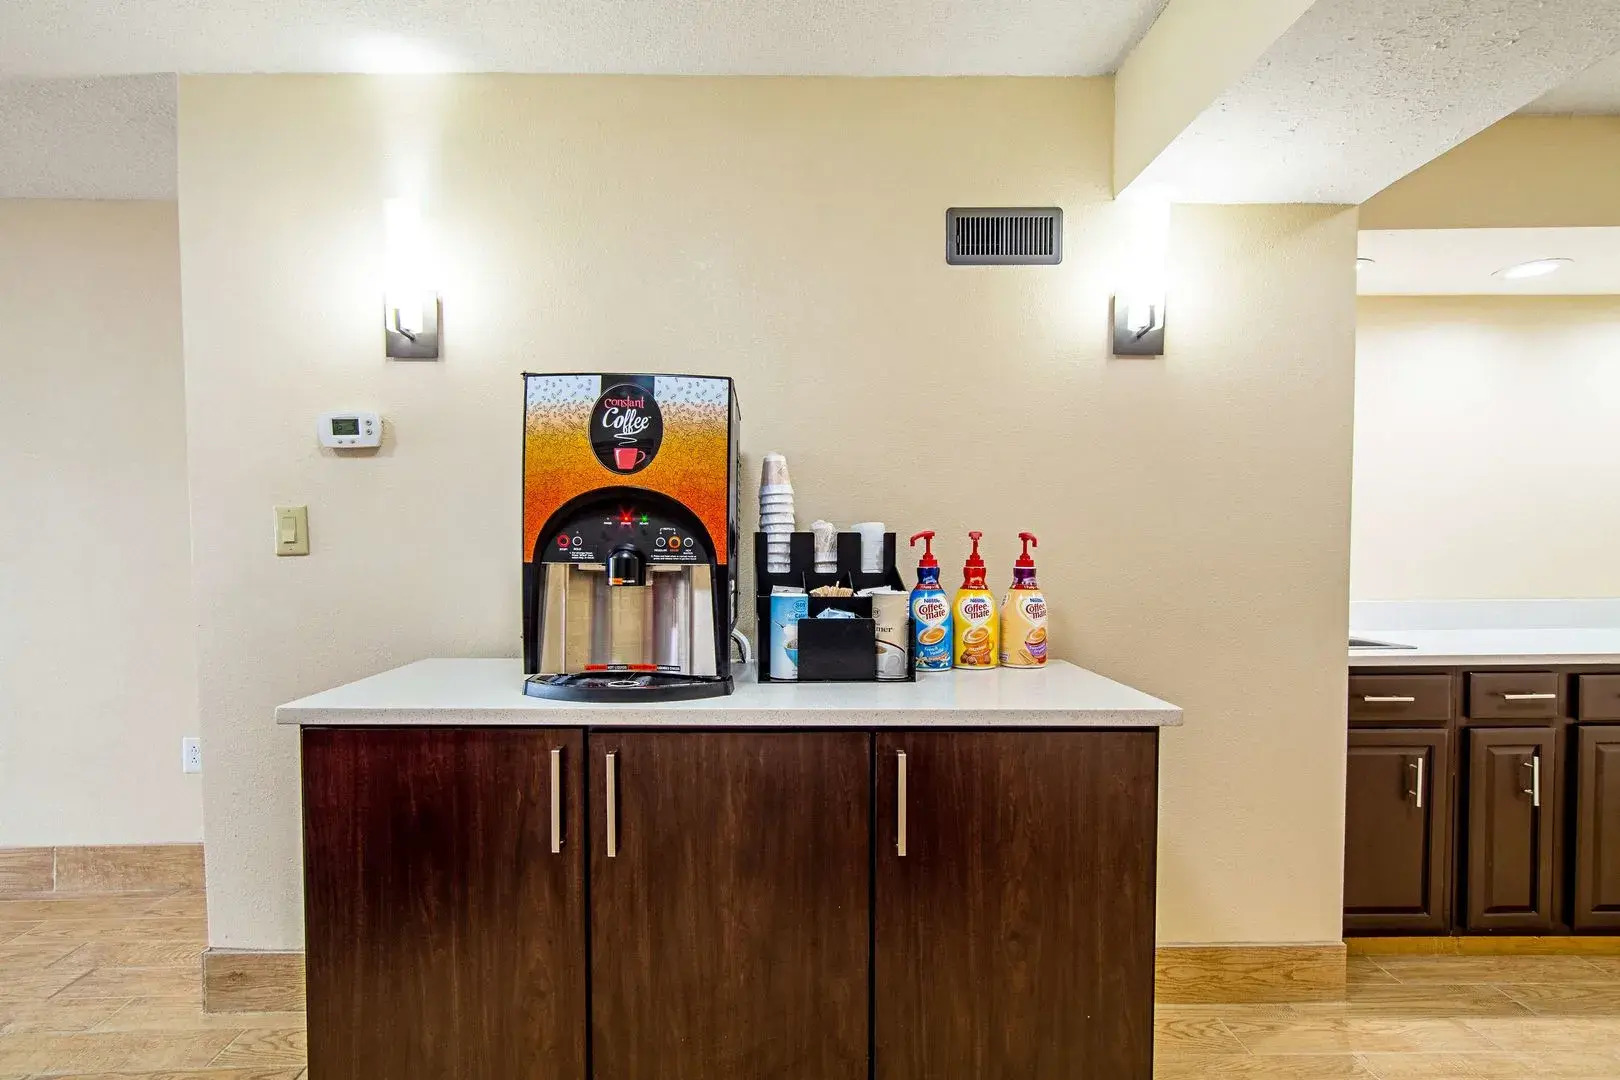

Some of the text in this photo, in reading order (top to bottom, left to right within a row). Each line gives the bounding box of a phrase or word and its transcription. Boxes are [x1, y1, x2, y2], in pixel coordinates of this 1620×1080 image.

[602, 407, 650, 435] Coffee
[925, 609, 946, 620] mate
[970, 610, 990, 620] mate
